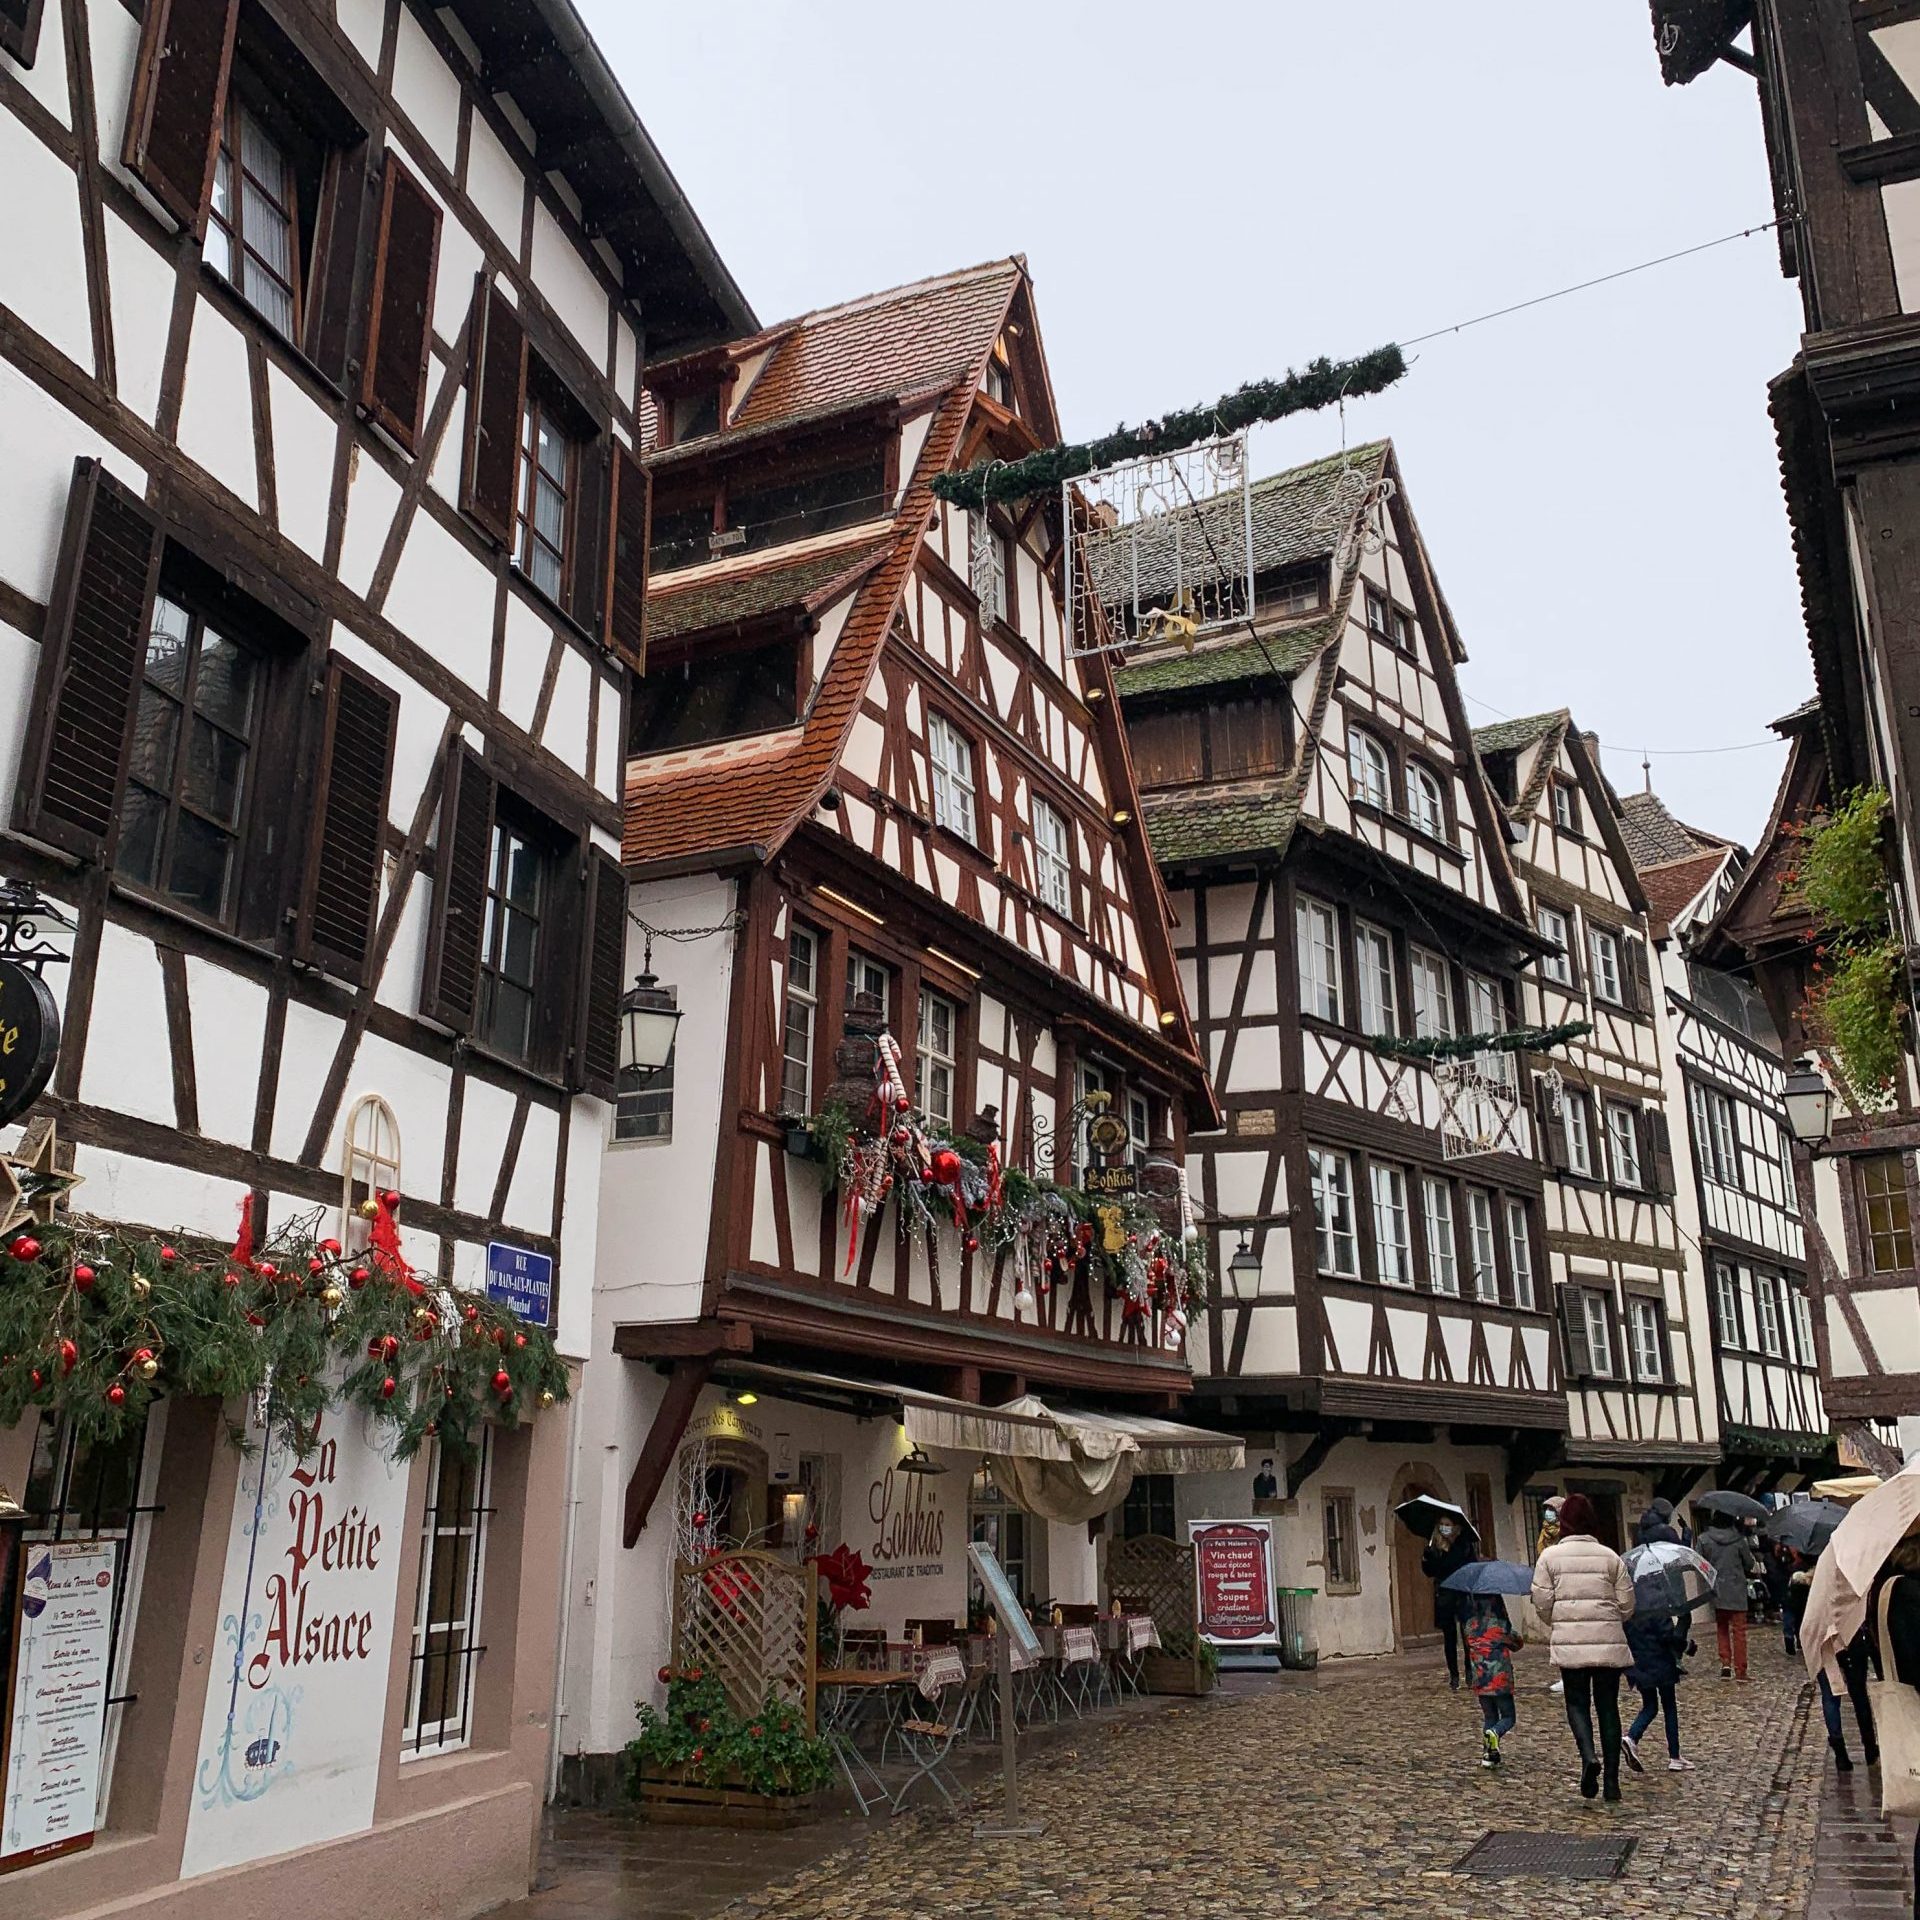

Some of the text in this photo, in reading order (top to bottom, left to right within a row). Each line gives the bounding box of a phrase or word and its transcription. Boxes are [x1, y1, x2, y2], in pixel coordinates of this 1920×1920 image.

[515, 1255, 528, 1271] RUE
[489, 1269, 549, 1298] DU BAIN-AUX-PLANTES
[869, 1466, 944, 1561] Lohkäs
[285, 1489, 381, 1598] Petite
[1210, 1551, 1253, 1559] Vin chaud
[872, 1563, 944, 1580] ESTAURANT DE TRADITION
[1228, 1560, 1251, 1571] épices
[1208, 1570, 1256, 1580] rouge & blanc
[1217, 1593, 1249, 1604] Soupes
[248, 1574, 372, 1690] Alsace
